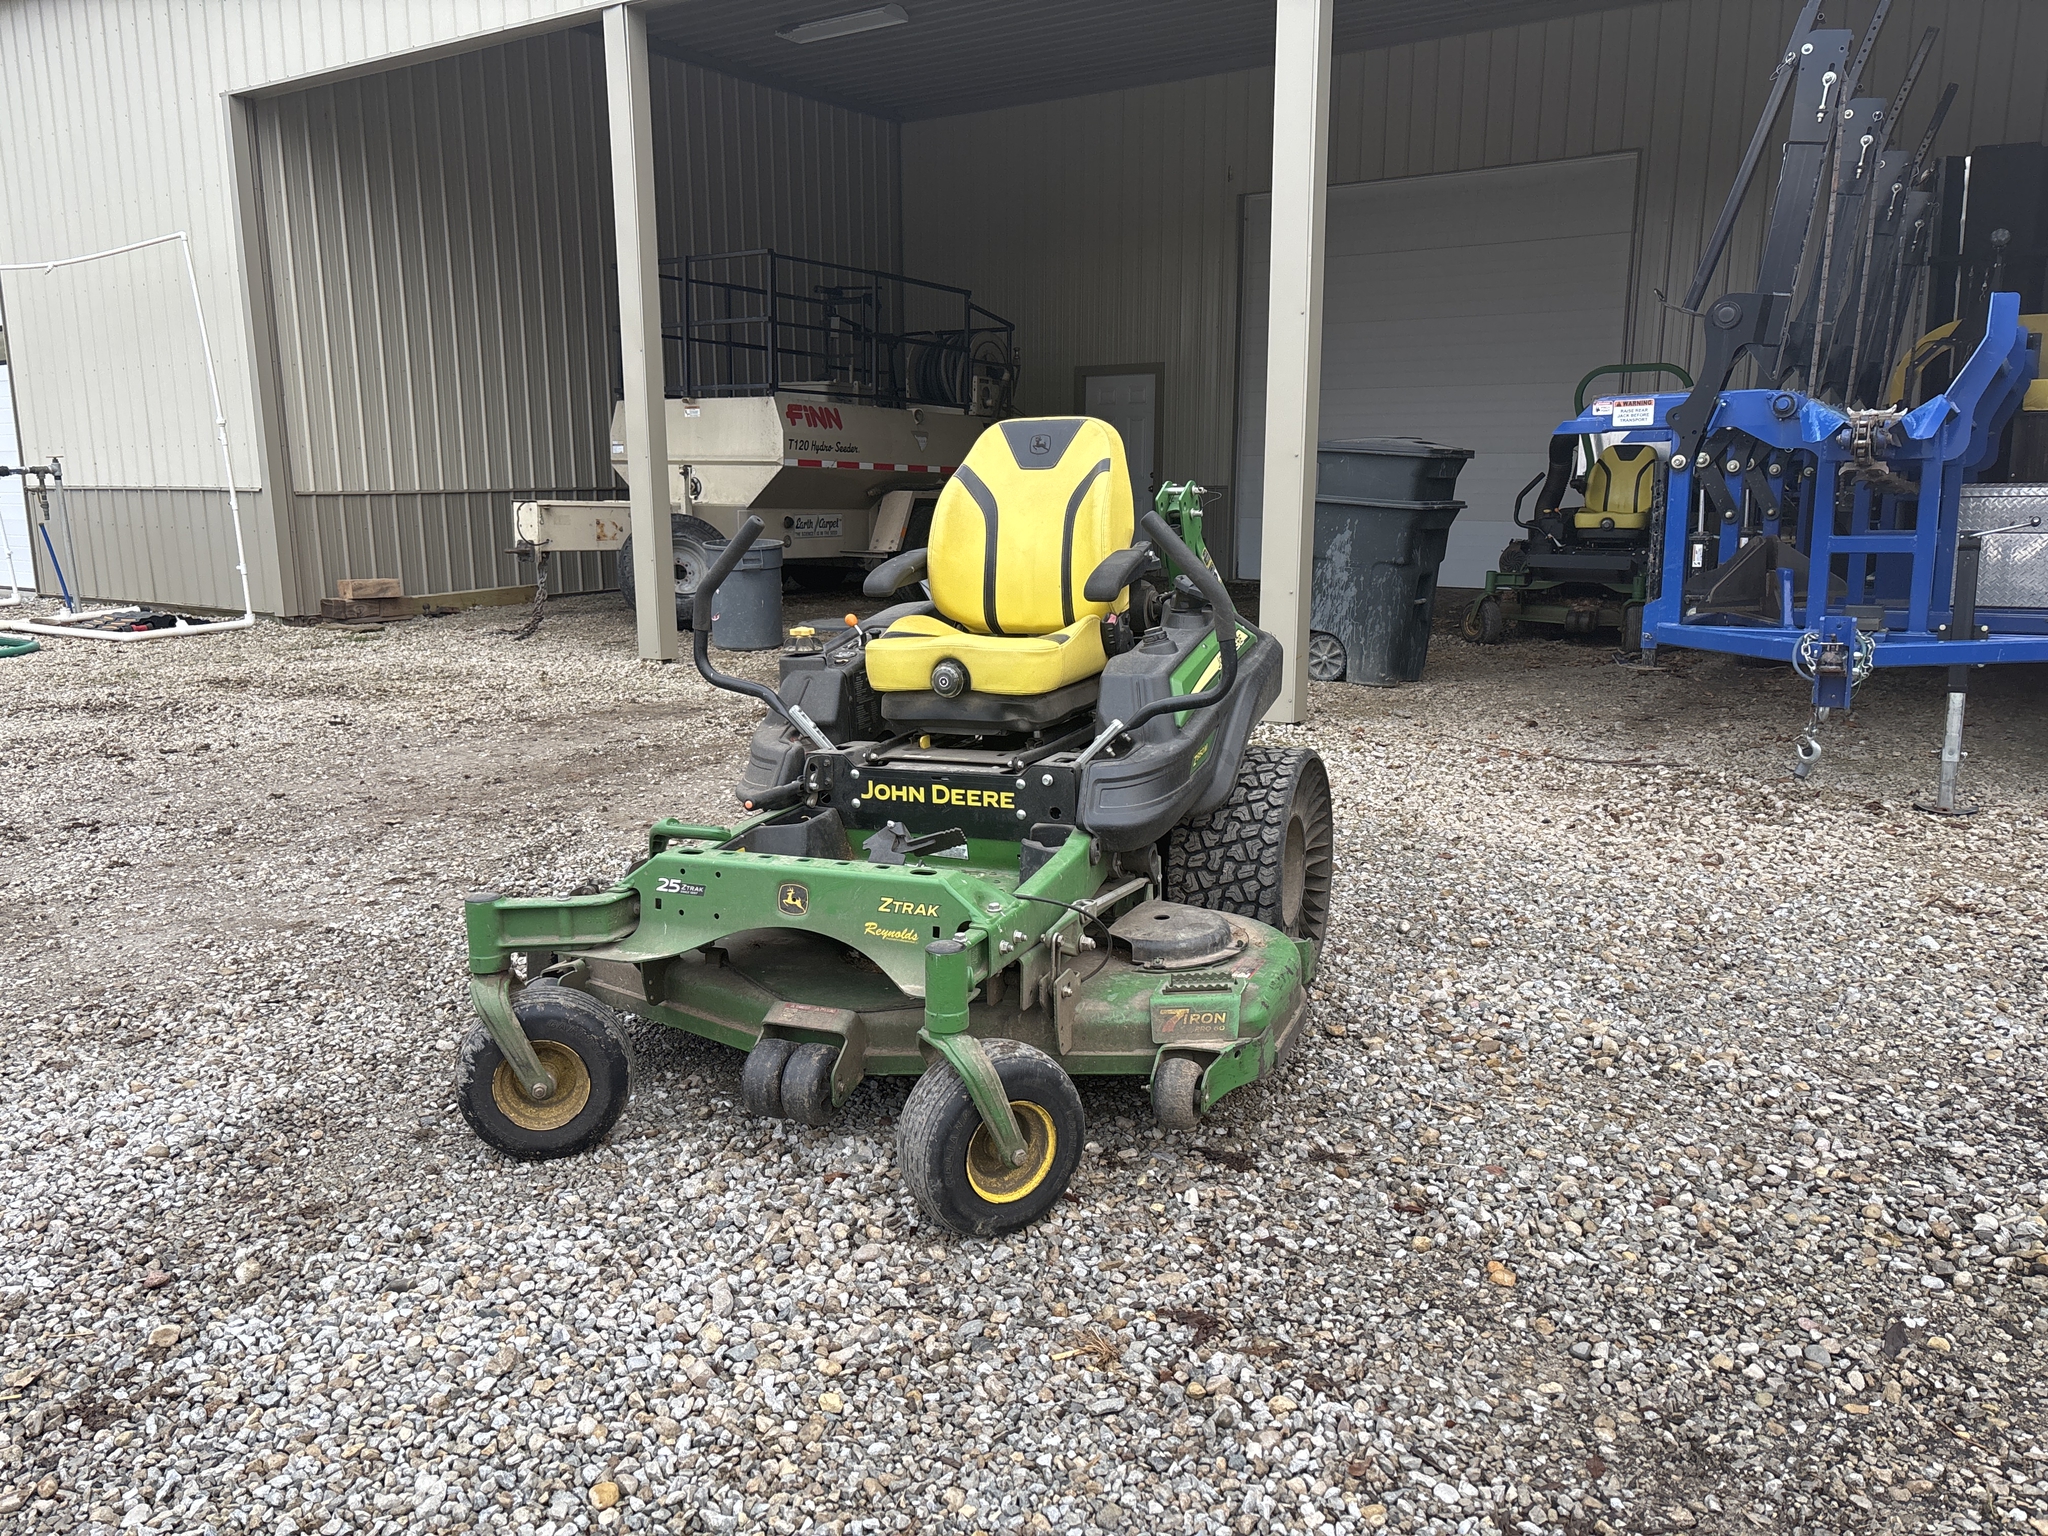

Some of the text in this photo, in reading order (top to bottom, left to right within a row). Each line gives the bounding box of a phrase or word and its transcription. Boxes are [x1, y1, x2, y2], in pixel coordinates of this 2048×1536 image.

[788, 438, 858, 454] T120 Hydro Seeder
[861, 780, 1015, 809] JOHN DEERE
[655, 877, 704, 893] 25 ZTRAK
[878, 896, 941, 917] ZTRAK
[864, 922, 918, 940] Reynolds
